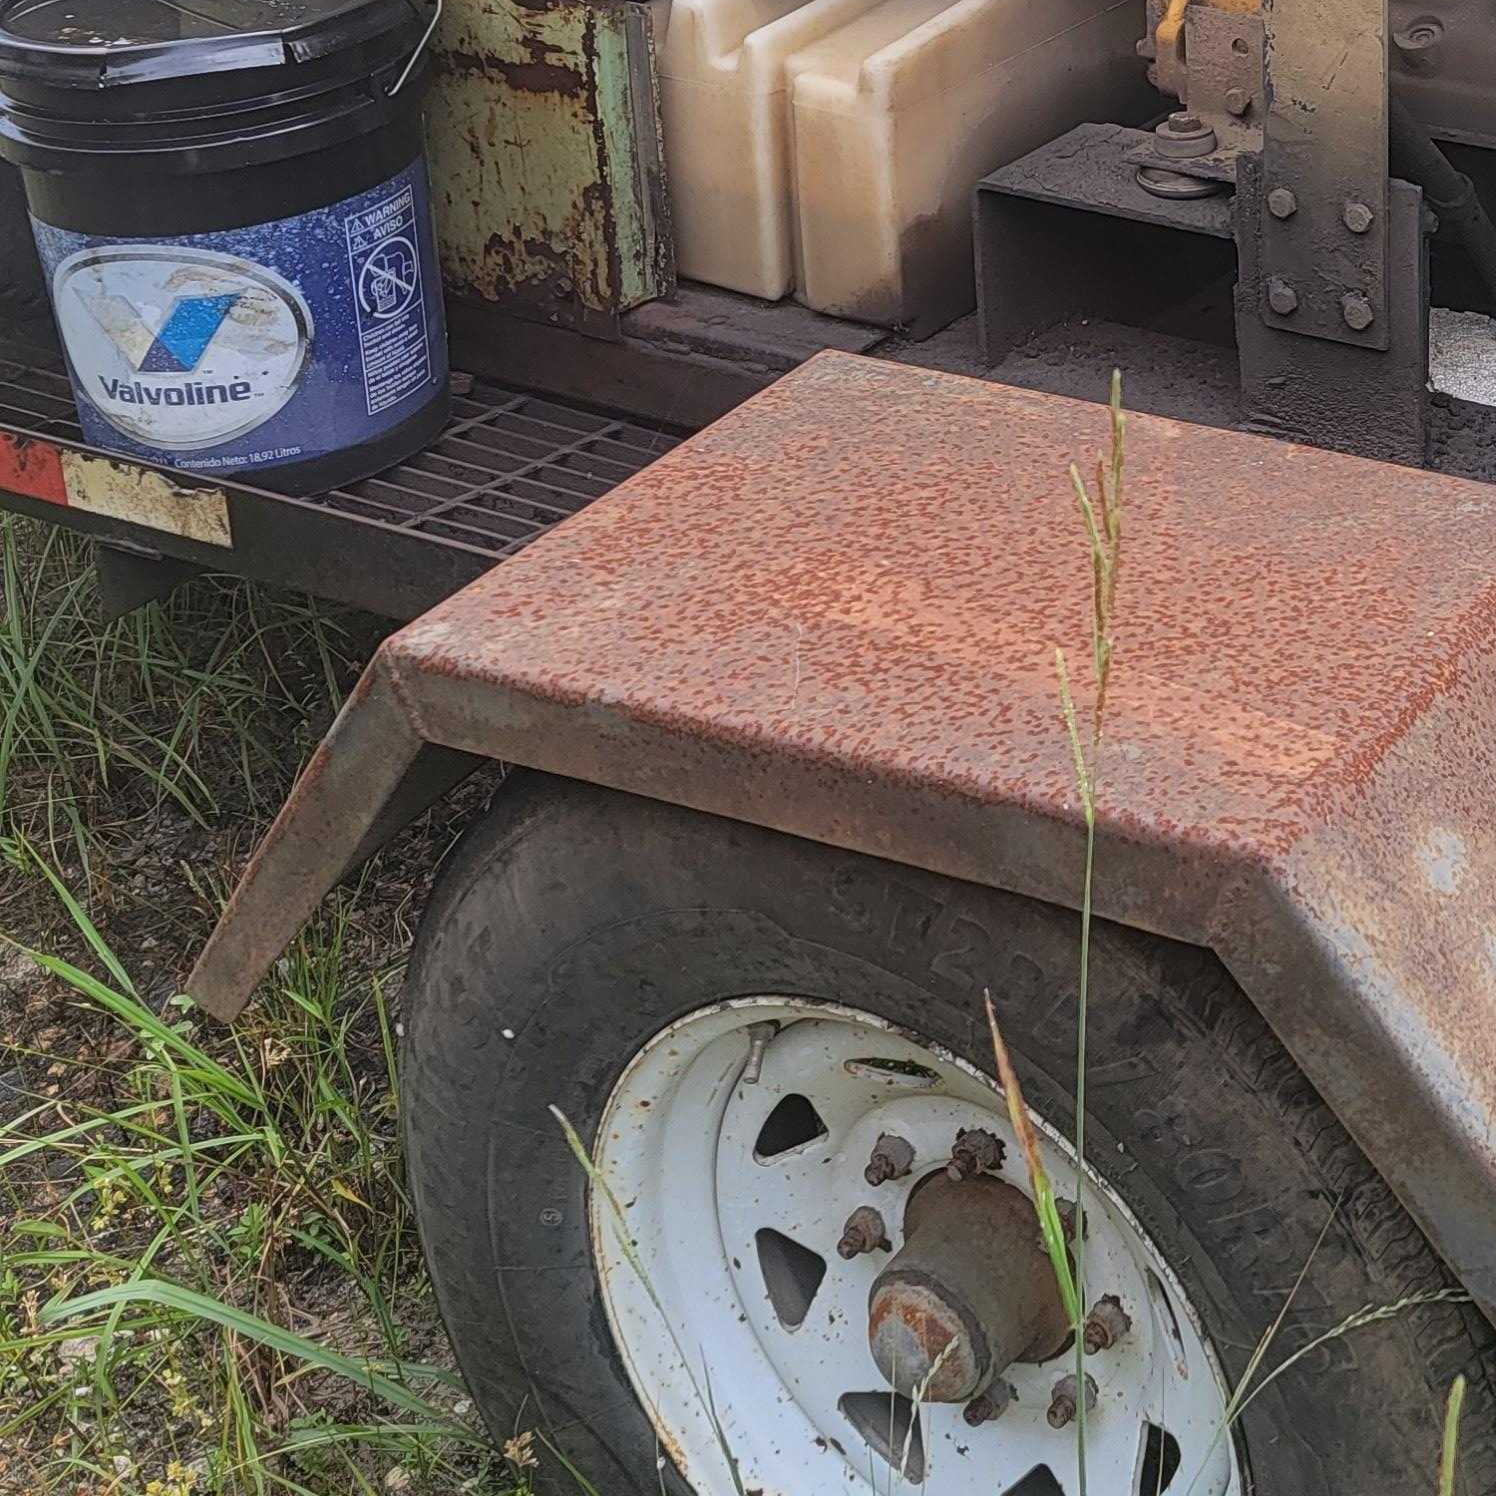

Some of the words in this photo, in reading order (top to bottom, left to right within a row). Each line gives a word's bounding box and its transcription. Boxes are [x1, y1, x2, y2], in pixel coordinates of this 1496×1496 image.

[364, 192, 411, 225] WARNING
[373, 215, 404, 240] AVISO
[97, 374, 252, 406] Valvoline
[173, 457, 221, 470] Contenido
[222, 455, 248, 467] Neto:
[275, 445, 301, 459] Litros
